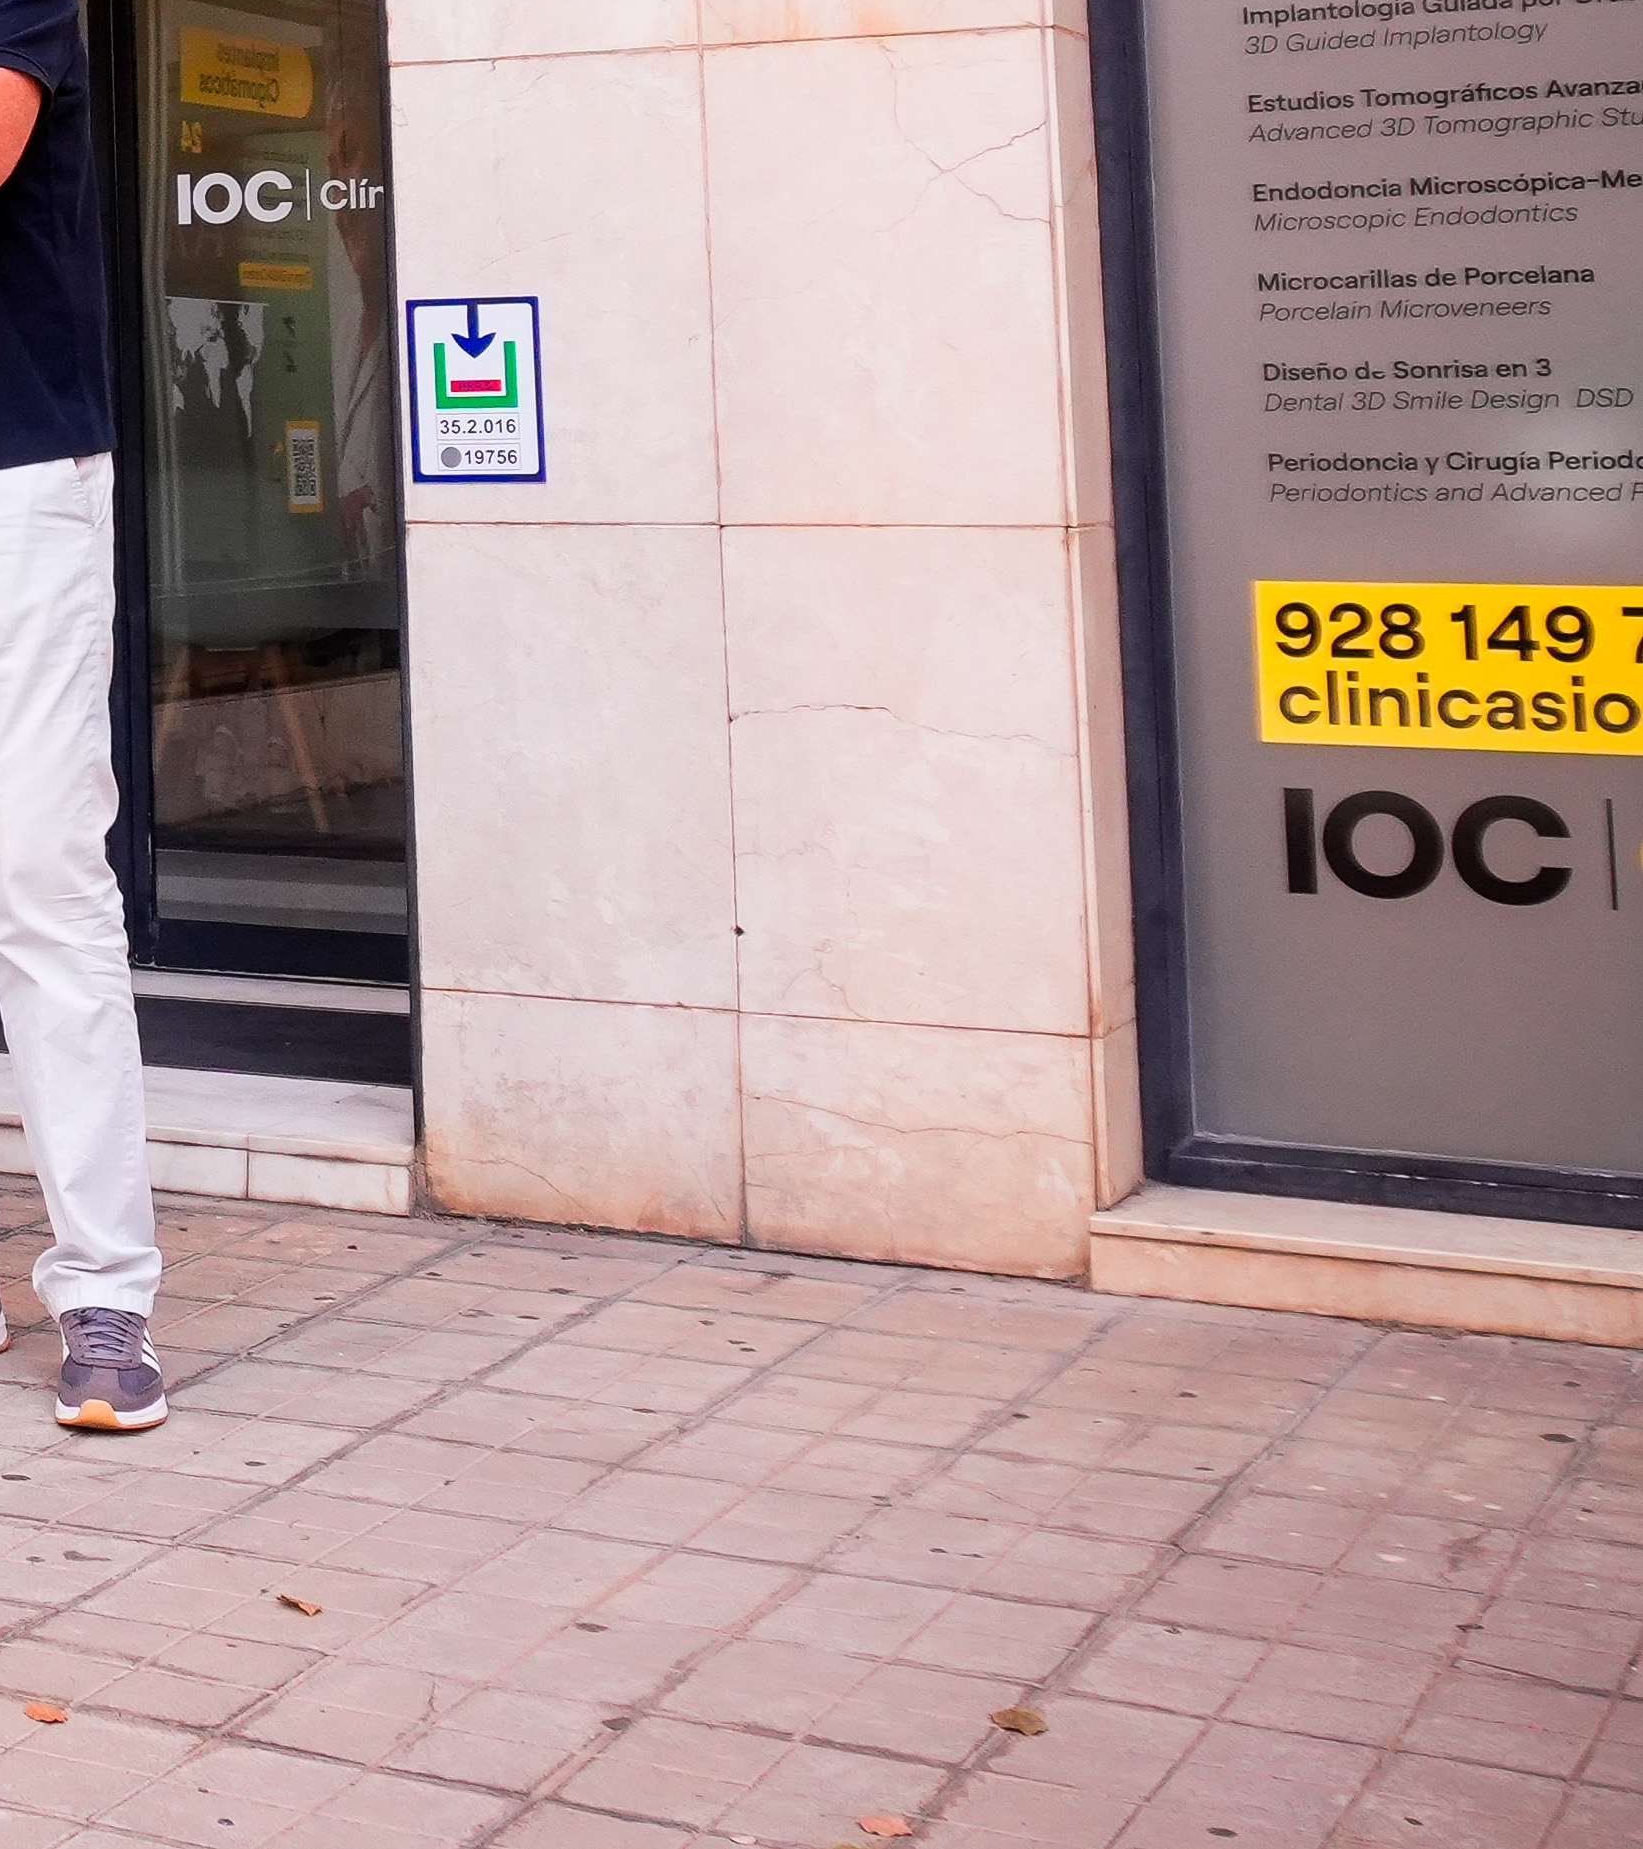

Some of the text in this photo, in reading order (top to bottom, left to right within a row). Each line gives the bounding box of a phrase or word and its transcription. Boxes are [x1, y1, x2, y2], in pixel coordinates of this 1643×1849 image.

[1243, 19, 1550, 56] 3D Guided Implantology
[1247, 78, 1643, 114] Estudios Tomográficos Avanza
[1248, 119, 1372, 144] Advanced
[1380, 117, 1416, 138] 3D
[1423, 106, 1595, 139] Tomographic
[177, 170, 294, 225] IOC
[1252, 177, 1403, 204] Endodoncia
[1253, 202, 1579, 235] Microscopic Endodontics
[1257, 264, 1596, 292] Microcarillas de Porcelana
[1259, 296, 1553, 322] Porcelain Microveneers
[1262, 360, 1349, 383] Diseño
[1393, 359, 1489, 380] Sonrisa
[1496, 362, 1528, 378] en
[1535, 357, 1553, 378] 3
[1264, 387, 1635, 415] Dental 3D Smile Design DSD
[439, 419, 517, 435] 35.2.016
[464, 450, 518, 465] 19756
[1267, 450, 1419, 474] Periodoncia
[1425, 454, 1441, 476] y
[1446, 448, 1542, 476] Cirugía
[1269, 482, 1429, 504] Periodontics
[1435, 481, 1484, 503] and
[1490, 481, 1623, 503] Advanced
[1275, 601, 1426, 660] 928
[1450, 604, 1596, 663] 149
[1278, 669, 1642, 734] clinicasio
[1282, 786, 1574, 907] IOC
